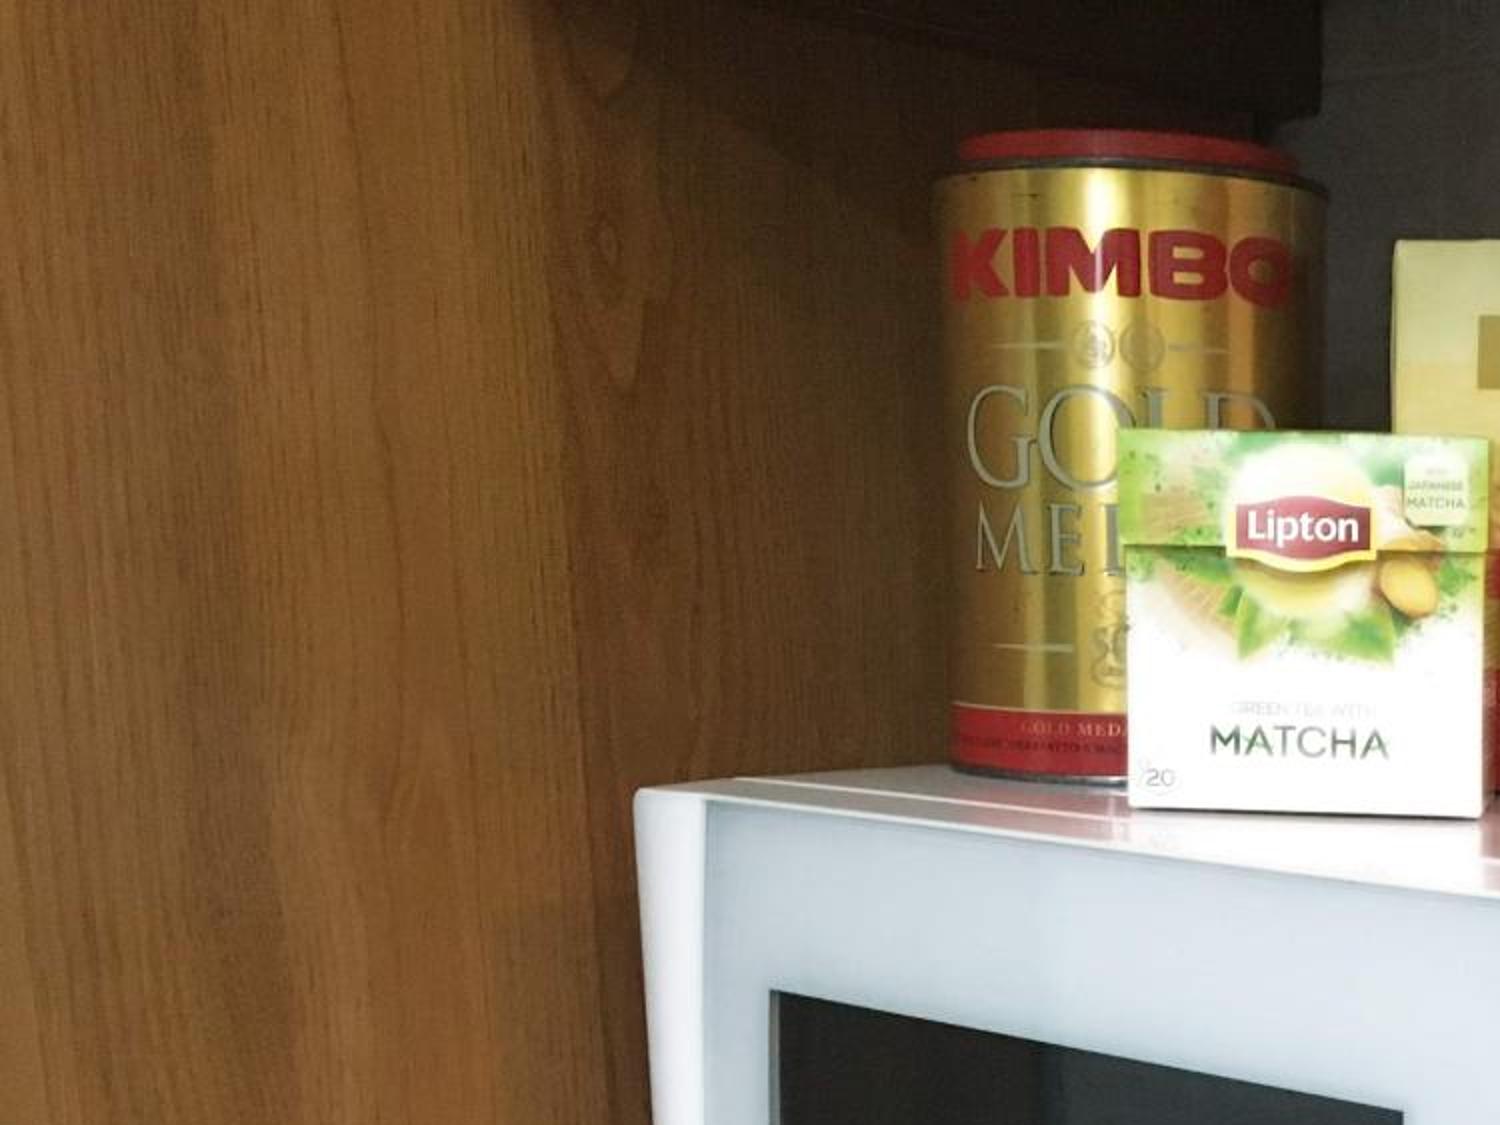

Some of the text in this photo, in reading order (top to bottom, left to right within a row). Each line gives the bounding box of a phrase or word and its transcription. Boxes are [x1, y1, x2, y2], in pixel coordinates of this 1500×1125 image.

[949, 226, 1292, 310] KIMBO
[1248, 508, 1360, 549] Lipton
[1077, 720, 1127, 738] MED
[1210, 724, 1390, 760] MATCHA
[1145, 767, 1176, 787] 20
